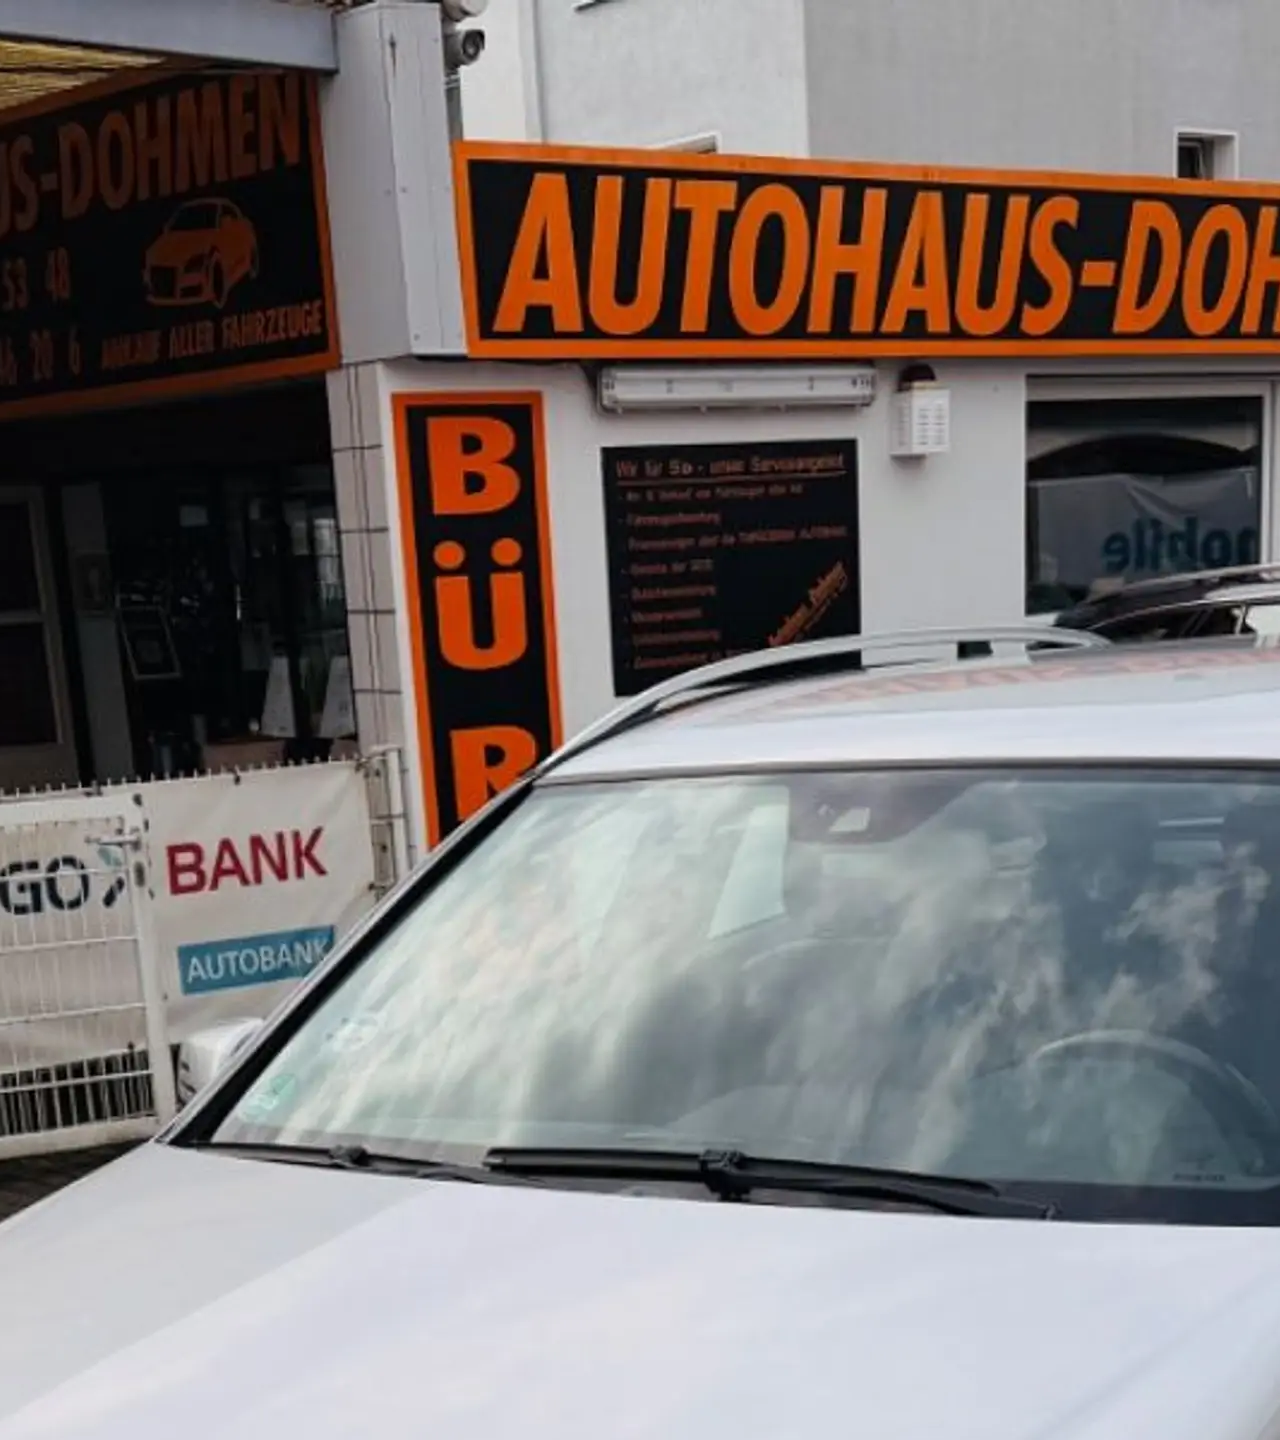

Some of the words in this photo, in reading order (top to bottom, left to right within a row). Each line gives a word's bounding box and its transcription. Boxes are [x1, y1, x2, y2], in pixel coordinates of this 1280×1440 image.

[169, 321, 216, 360] ALLER
[222, 299, 323, 350] FAHRZEUGE
[166, 827, 329, 895] BANK
[187, 935, 330, 983] AUTOBANK
